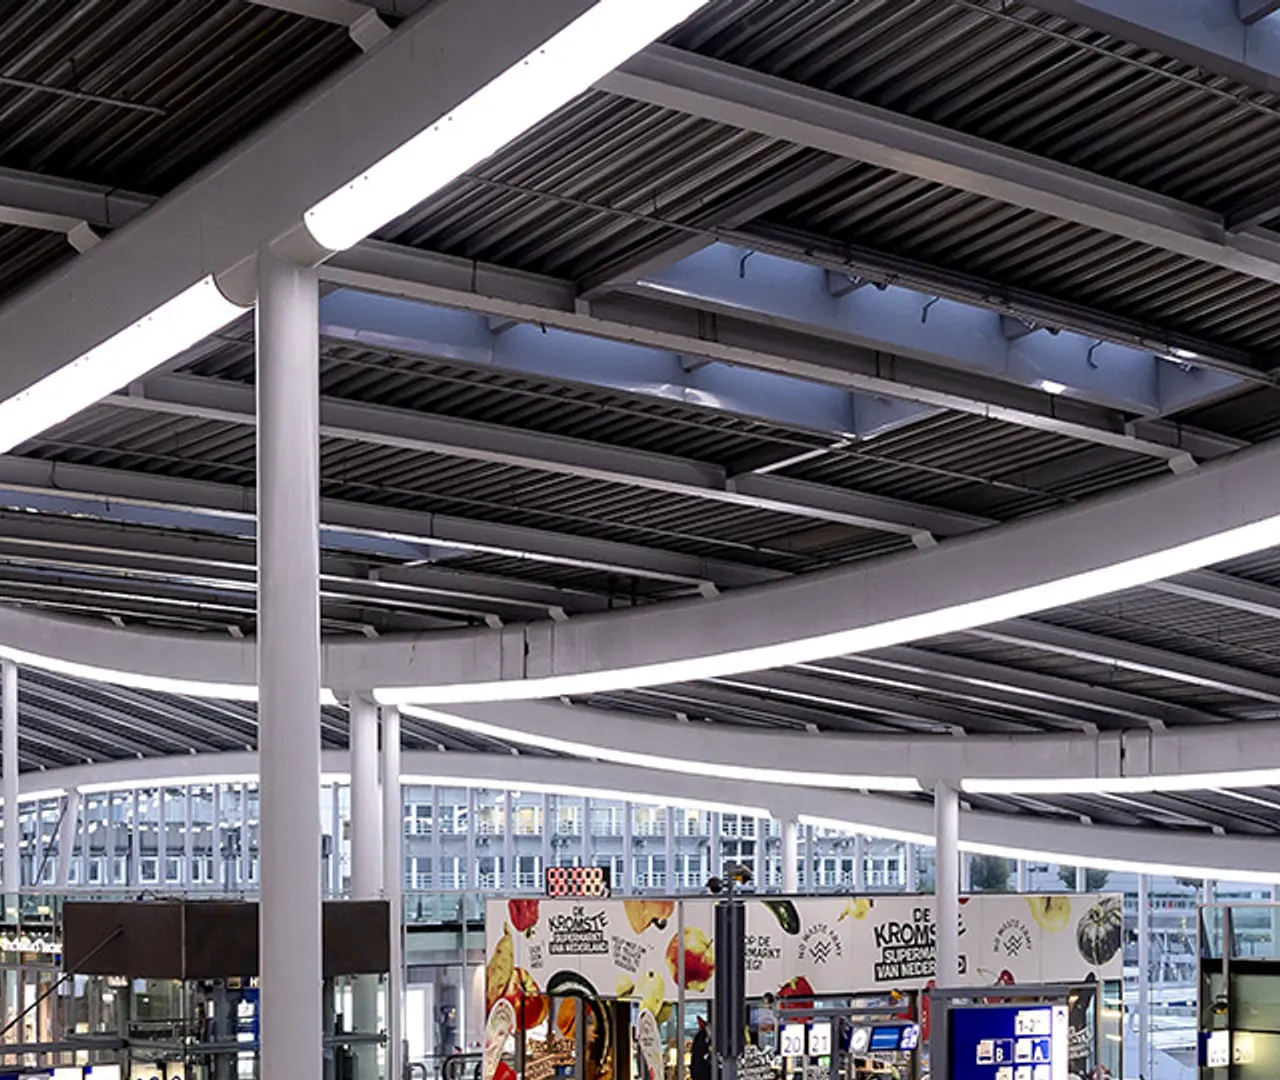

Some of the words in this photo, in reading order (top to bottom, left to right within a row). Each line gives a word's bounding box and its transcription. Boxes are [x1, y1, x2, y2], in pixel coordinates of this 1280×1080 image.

[548, 909, 609, 932] KROMSTE
[913, 907, 931, 923] DE
[876, 964, 899, 979] VAN
[784, 1036, 801, 1053] 20
[811, 1036, 828, 1052] 21
